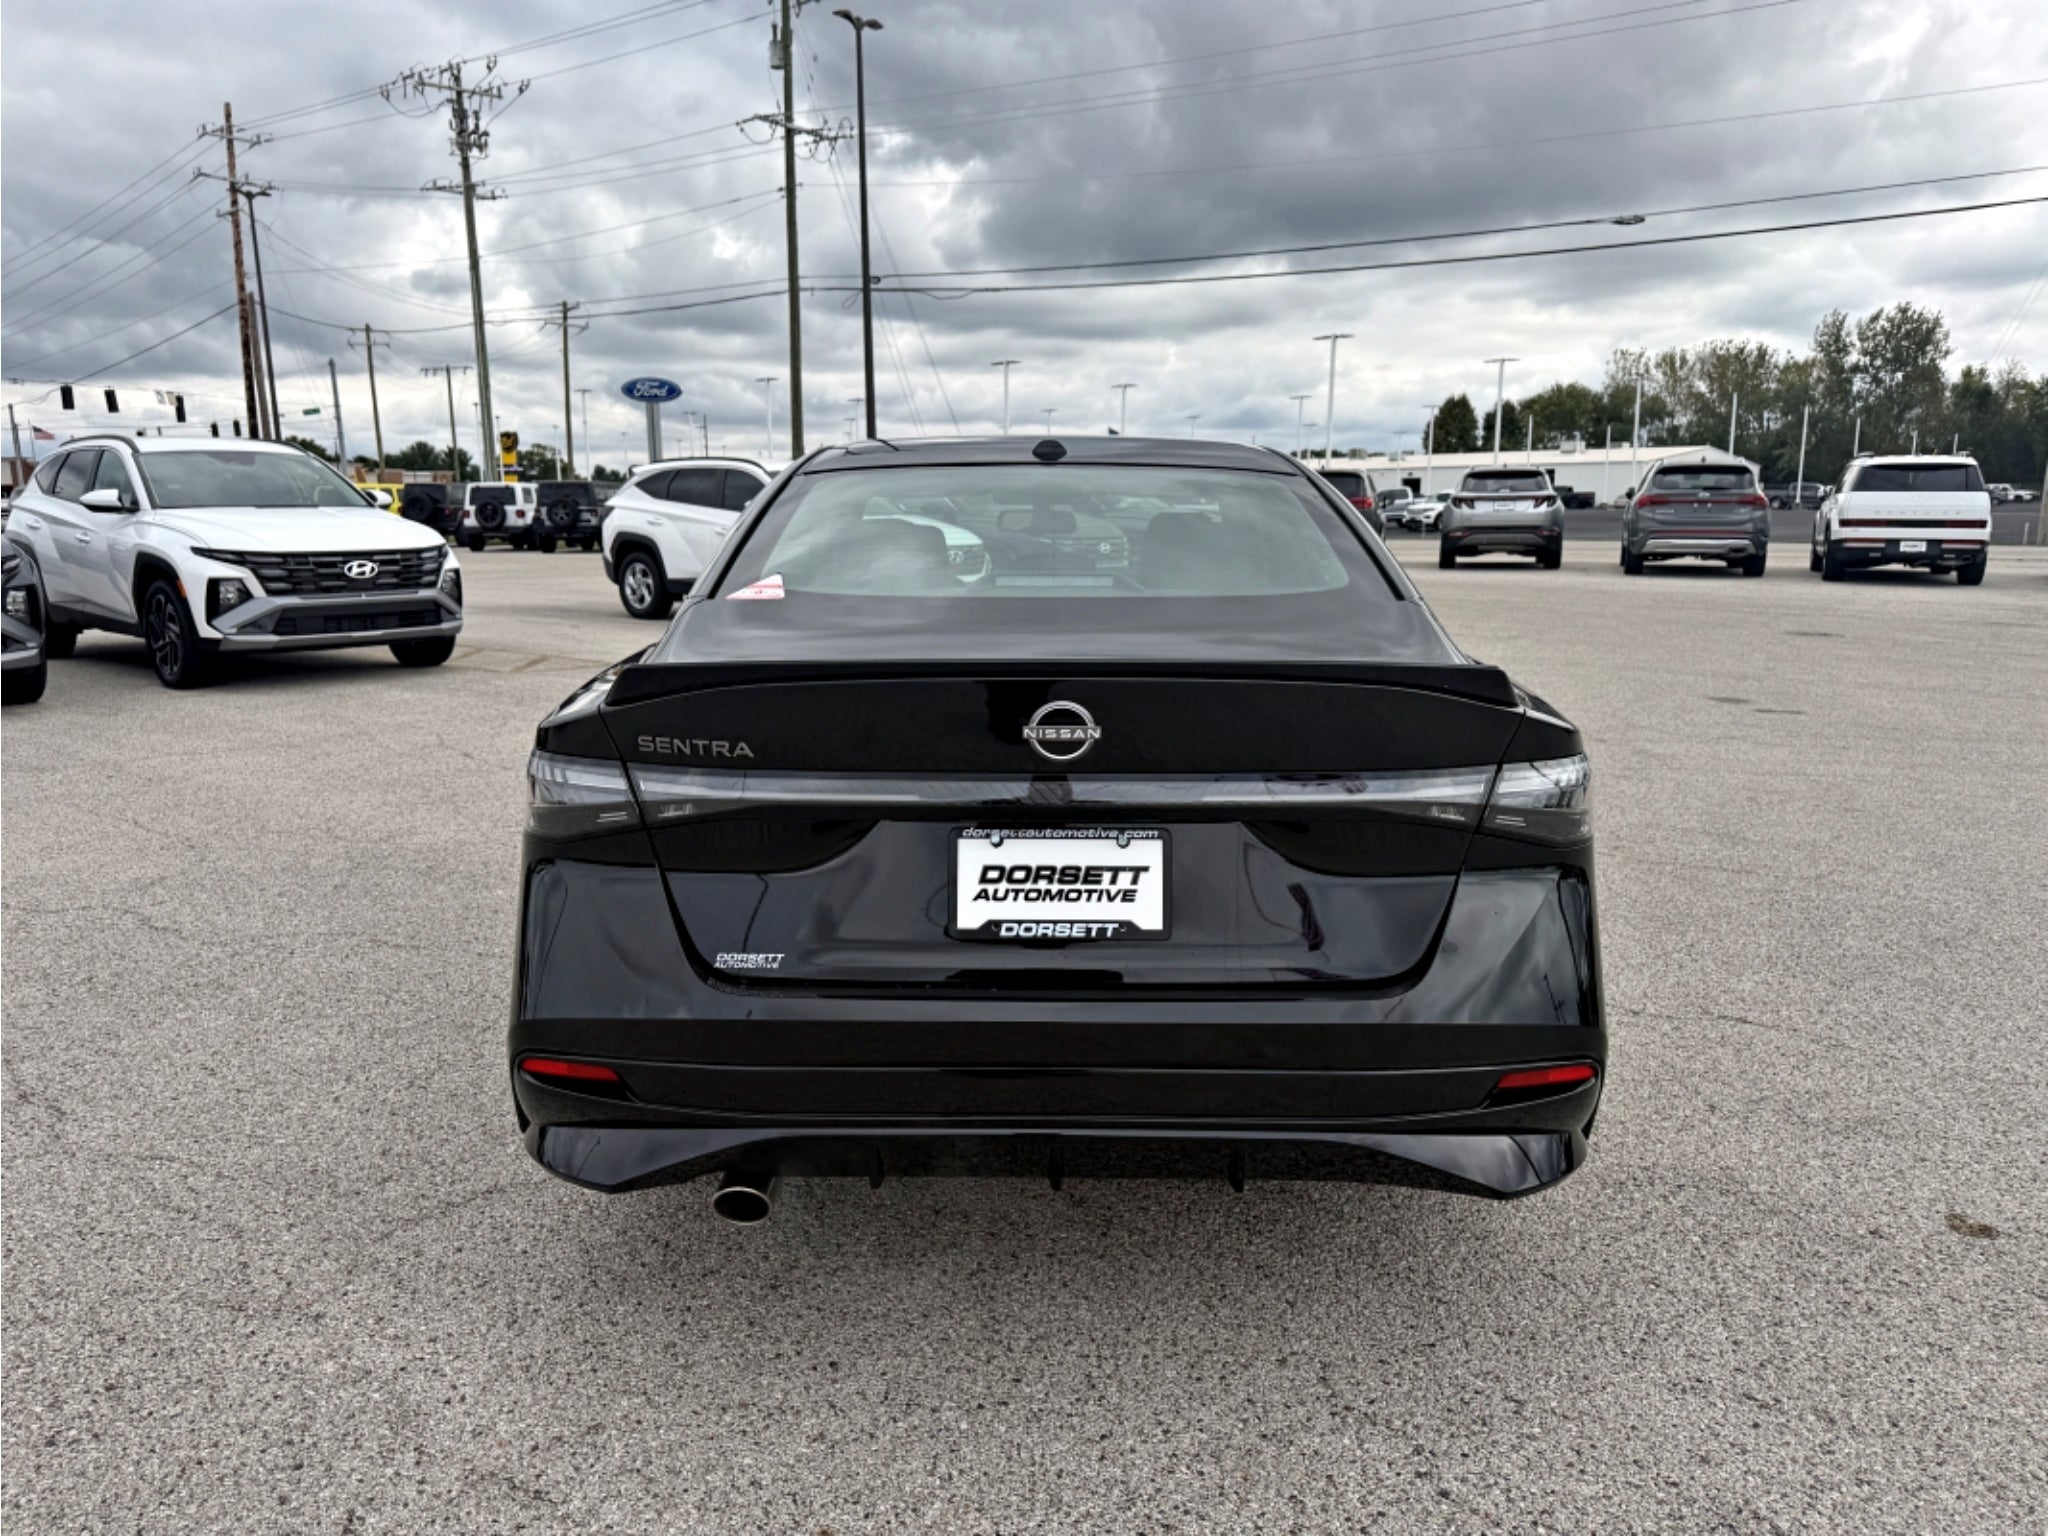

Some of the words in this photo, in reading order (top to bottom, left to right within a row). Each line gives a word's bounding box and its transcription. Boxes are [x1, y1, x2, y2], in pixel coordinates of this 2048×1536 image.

[634, 381, 668, 396] Ford
[1023, 728, 1101, 739] NISSAN
[637, 735, 755, 758] SENTRA
[978, 864, 1150, 886] DORSETT
[972, 888, 1138, 903] AUTOMOTIVE
[1000, 922, 1119, 938] DORSETT
[716, 953, 785, 961] DORSETT
